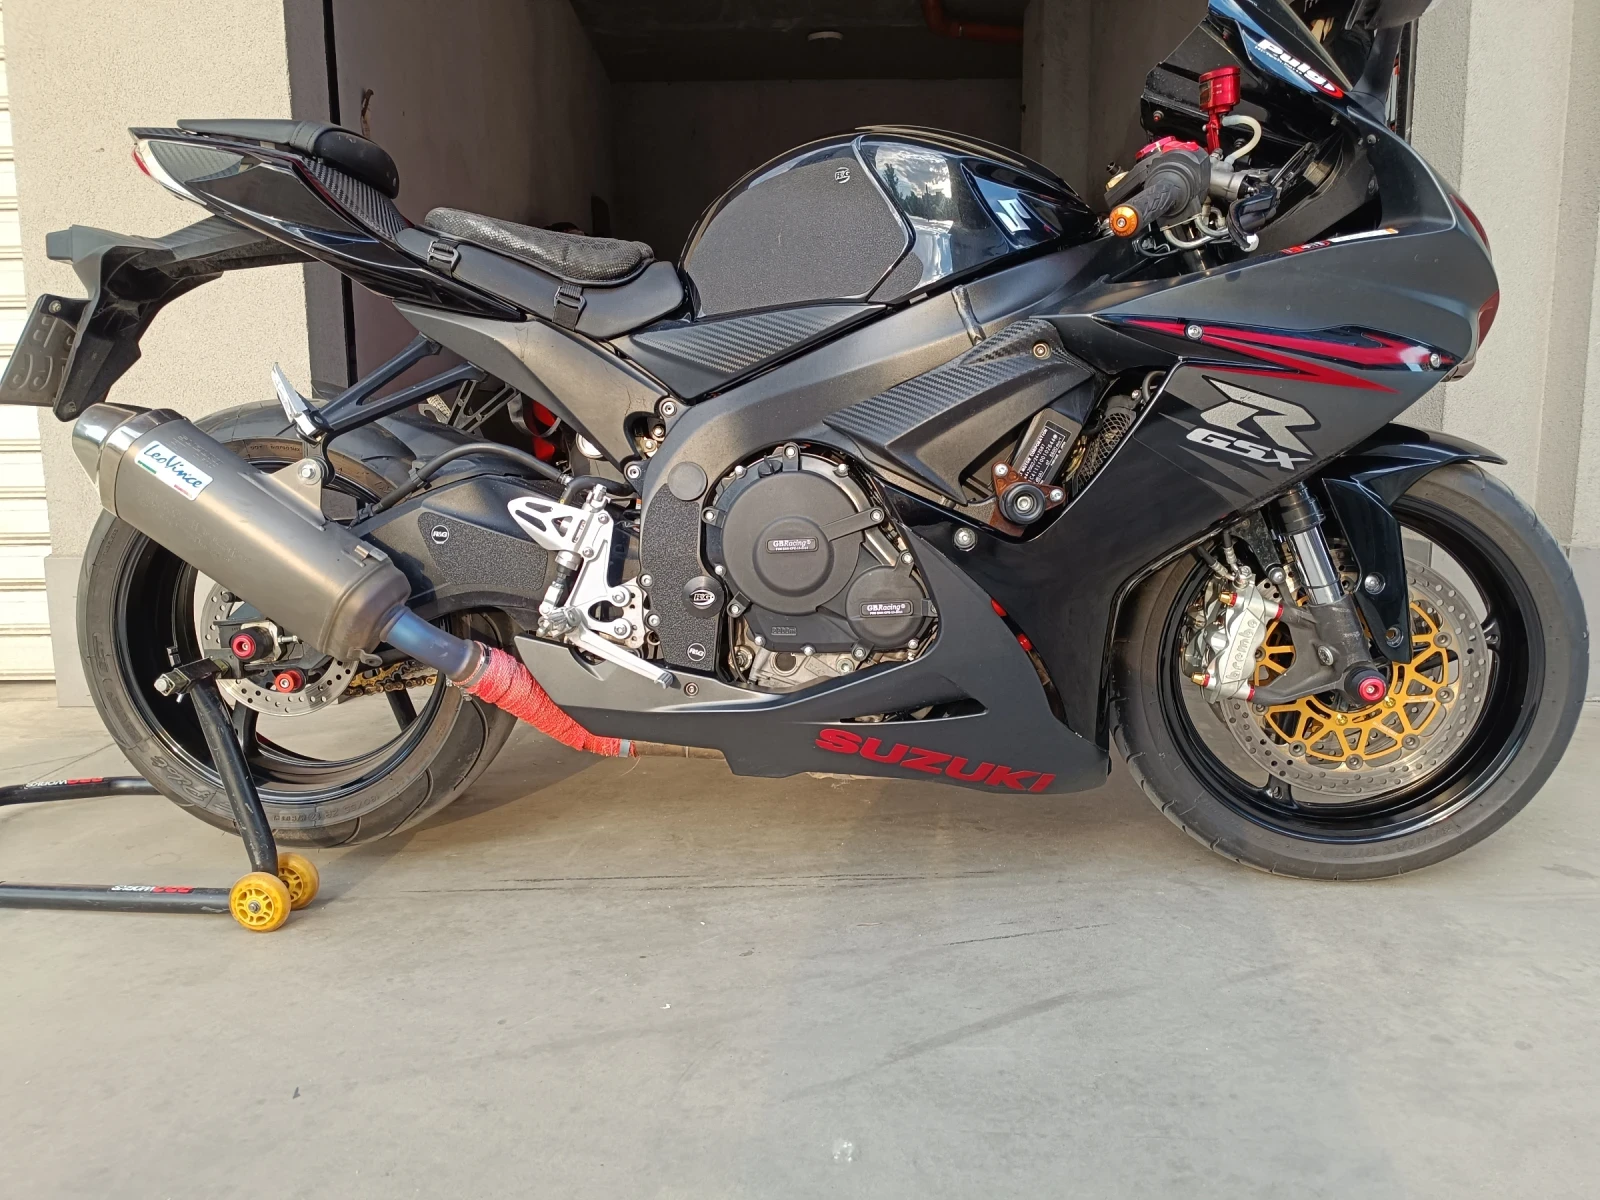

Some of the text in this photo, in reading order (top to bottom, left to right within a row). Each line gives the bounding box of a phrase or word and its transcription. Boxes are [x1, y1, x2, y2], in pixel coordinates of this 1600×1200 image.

[1200, 378, 1314, 456] R
[144, 444, 203, 489] LeoVince
[1186, 428, 1311, 470] GSX
[1226, 619, 1258, 679] brembo
[815, 728, 1057, 792] SUZUKI
